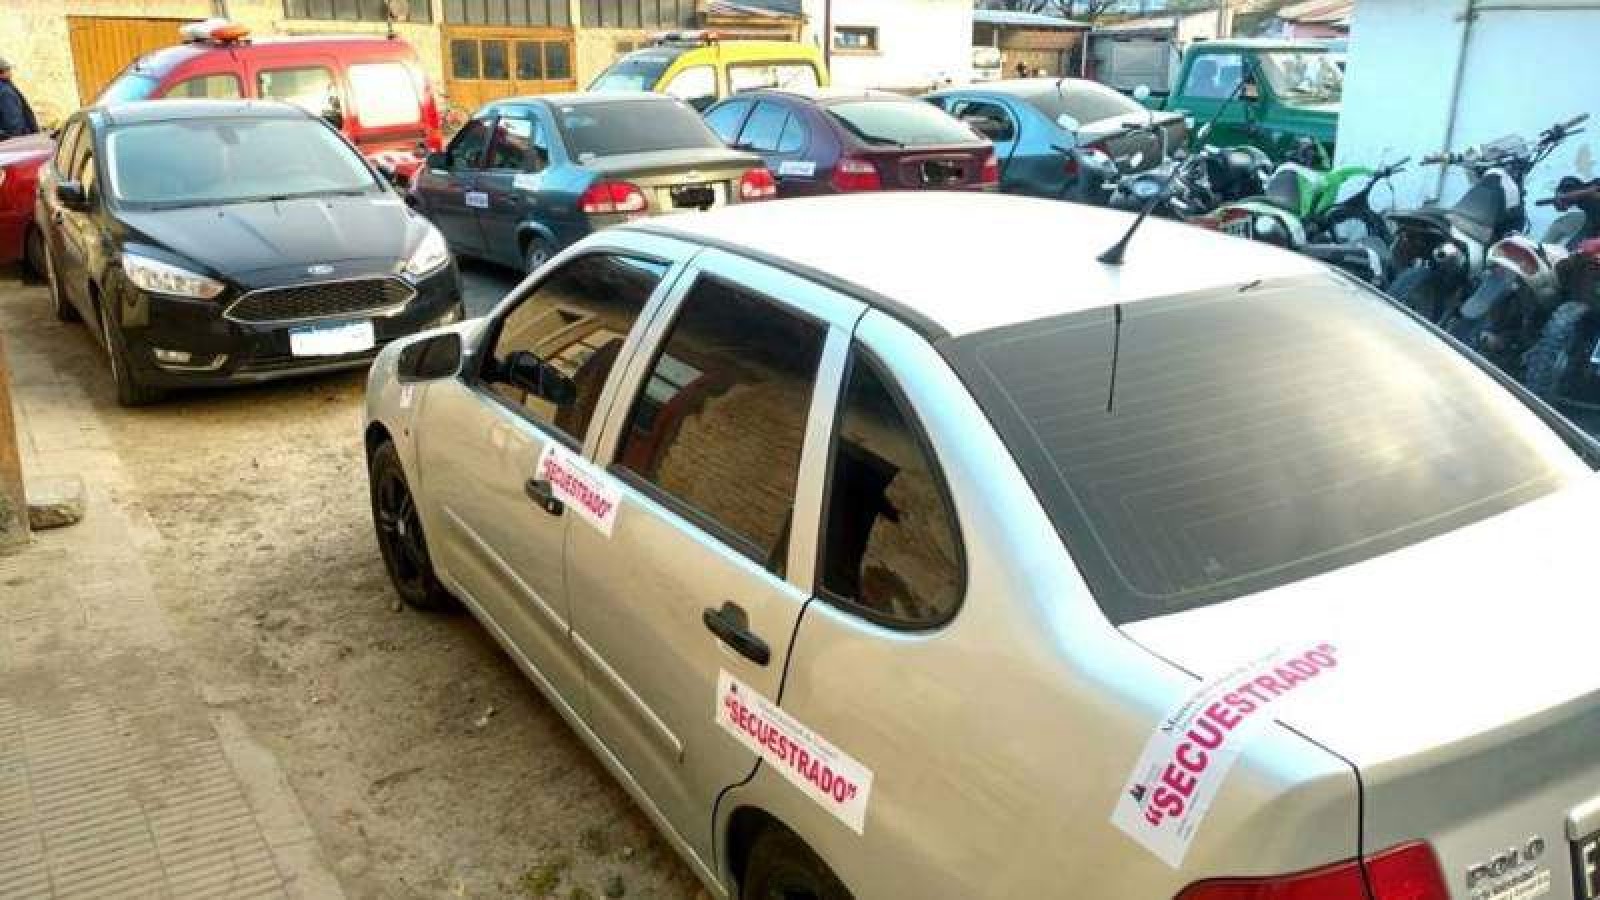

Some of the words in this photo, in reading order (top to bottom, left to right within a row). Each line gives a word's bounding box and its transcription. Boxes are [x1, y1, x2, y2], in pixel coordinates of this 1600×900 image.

[725, 696, 858, 802] “SECUESTRADO”
[1145, 641, 1336, 827] “SECUESTRADO”
[1466, 837, 1544, 889] POLO
